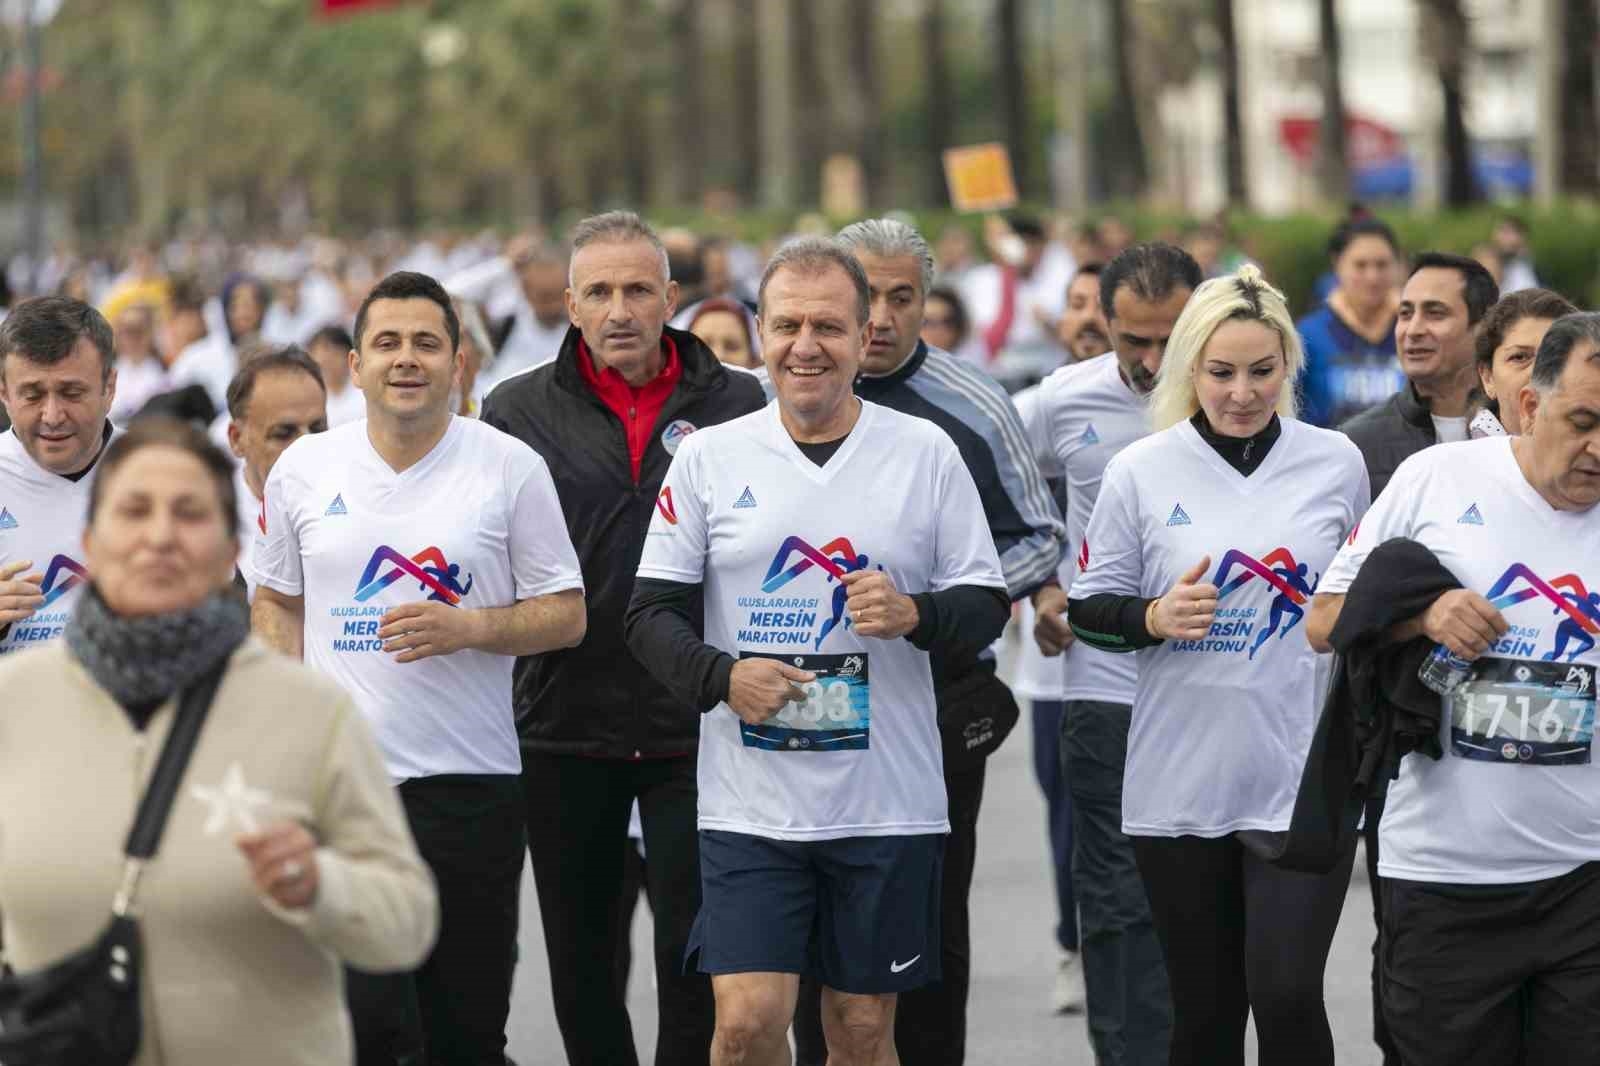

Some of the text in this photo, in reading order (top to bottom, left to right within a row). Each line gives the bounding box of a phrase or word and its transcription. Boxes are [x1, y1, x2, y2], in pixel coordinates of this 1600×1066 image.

[737, 597, 819, 608] ULUSLARARASI
[750, 609, 817, 627] MERSİN
[344, 620, 383, 636] MER
[737, 630, 811, 644] MARATONU
[333, 639, 388, 652] MARATO
[1462, 693, 1588, 743] 17167
